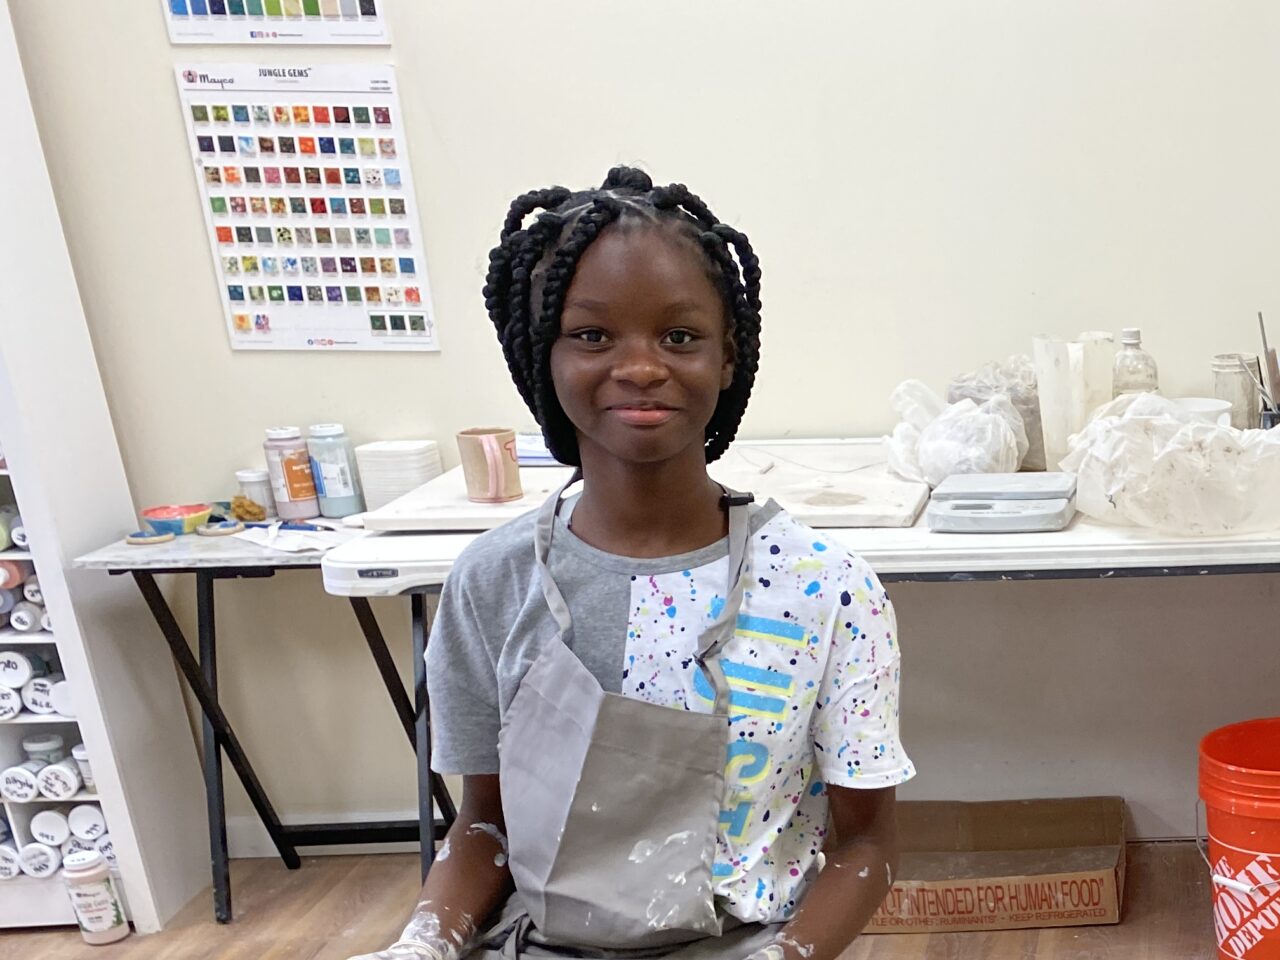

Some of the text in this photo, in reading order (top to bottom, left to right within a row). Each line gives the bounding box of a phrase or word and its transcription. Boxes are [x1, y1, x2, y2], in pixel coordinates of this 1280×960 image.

[258, 67, 285, 78] JUNGLE
[199, 73, 235, 89] Mayco
[905, 887, 975, 916] INTENDED
[977, 885, 1008, 914] FOR
[1008, 882, 1060, 912] HUMAN
[1009, 912, 1034, 922] KEEP
[1035, 908, 1106, 921] REFRIGERATED
